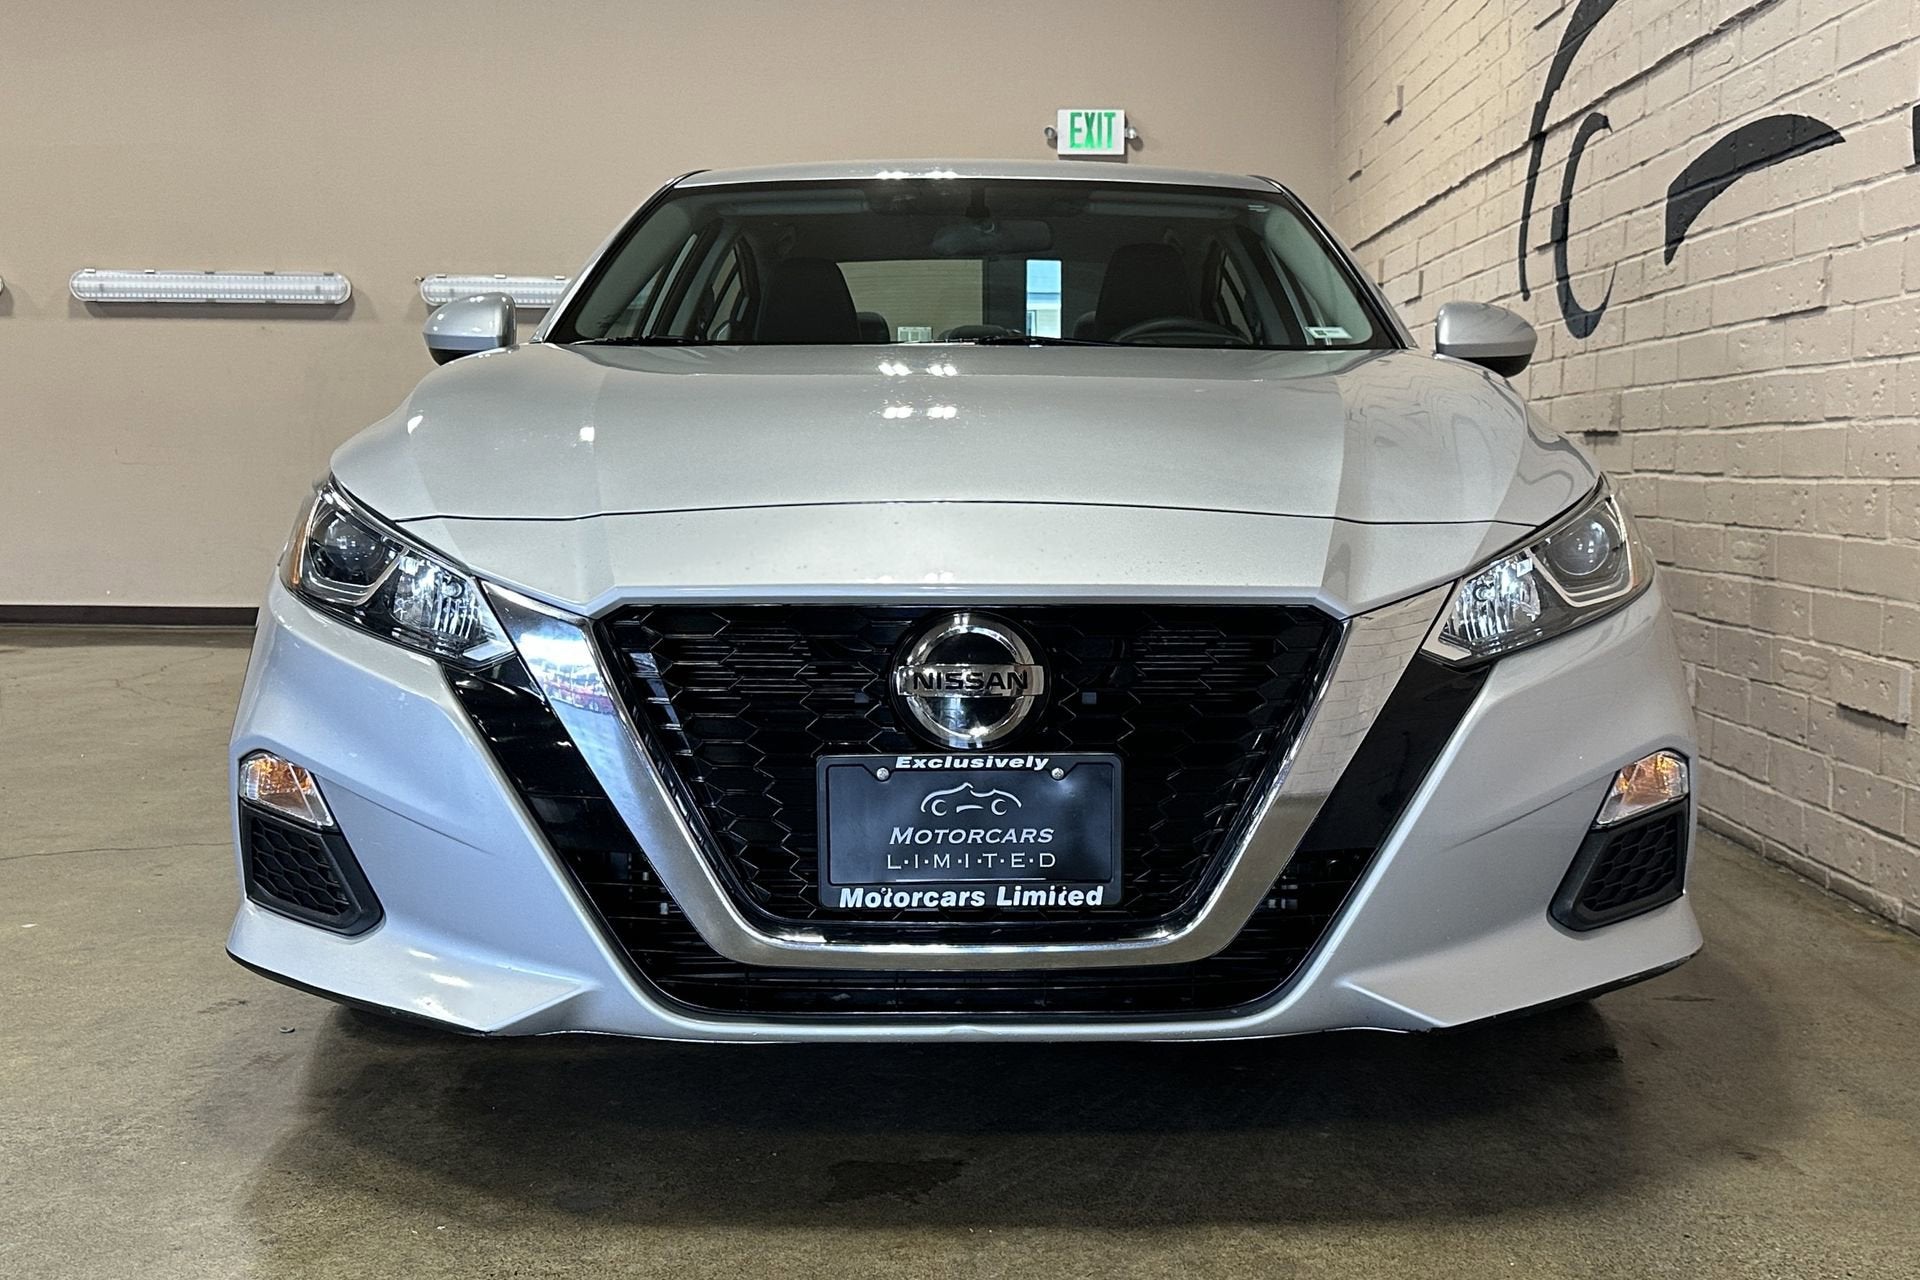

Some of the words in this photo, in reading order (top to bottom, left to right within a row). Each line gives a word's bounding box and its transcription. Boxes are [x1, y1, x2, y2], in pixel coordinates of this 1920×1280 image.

[1070, 112, 1116, 148] EXIT
[912, 671, 1029, 690] NISSAN
[895, 756, 1049, 770] Exclusively
[839, 887, 985, 908] Motorcars
[996, 886, 1104, 906] Limited
